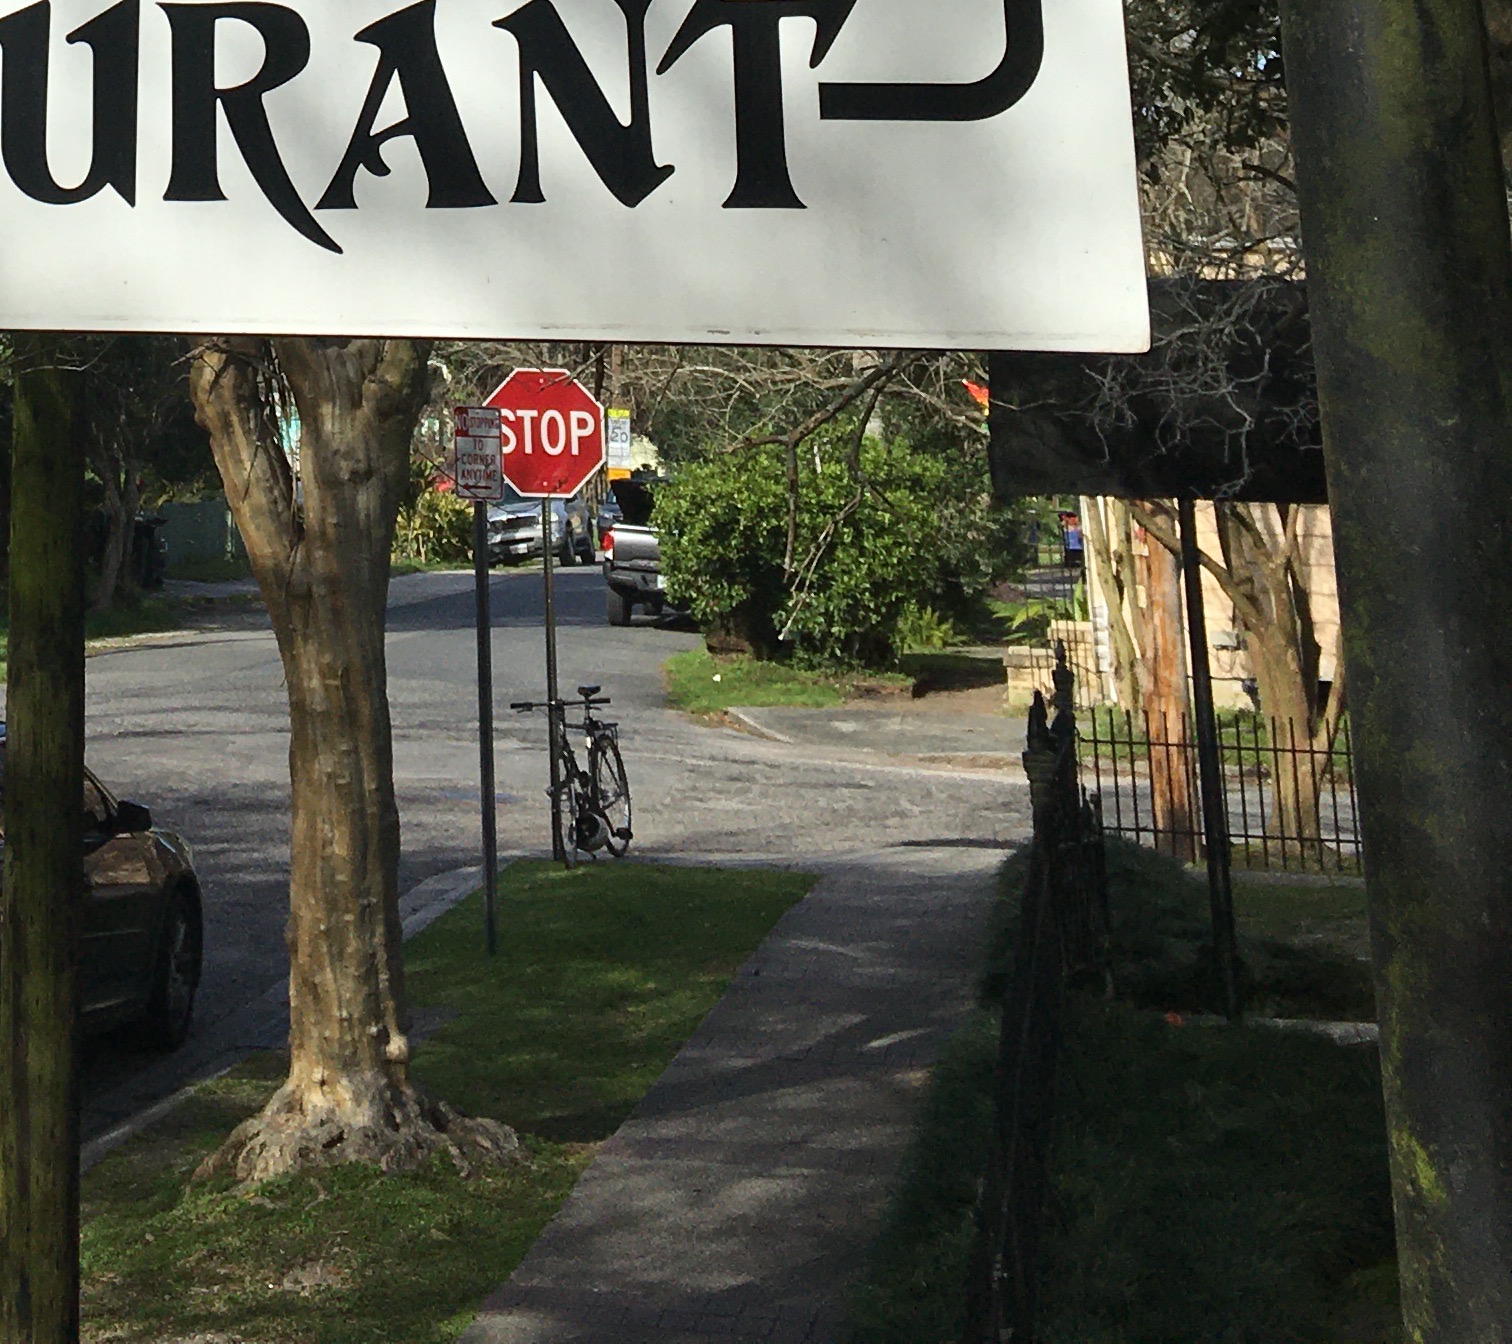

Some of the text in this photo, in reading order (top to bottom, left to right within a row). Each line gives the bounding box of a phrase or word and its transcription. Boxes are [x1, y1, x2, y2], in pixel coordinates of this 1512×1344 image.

[455, 414, 468, 431] NO
[501, 408, 595, 456] STOP
[473, 438, 484, 451] TO
[461, 453, 496, 466] CORNER
[460, 468, 498, 482] ANYTIME
